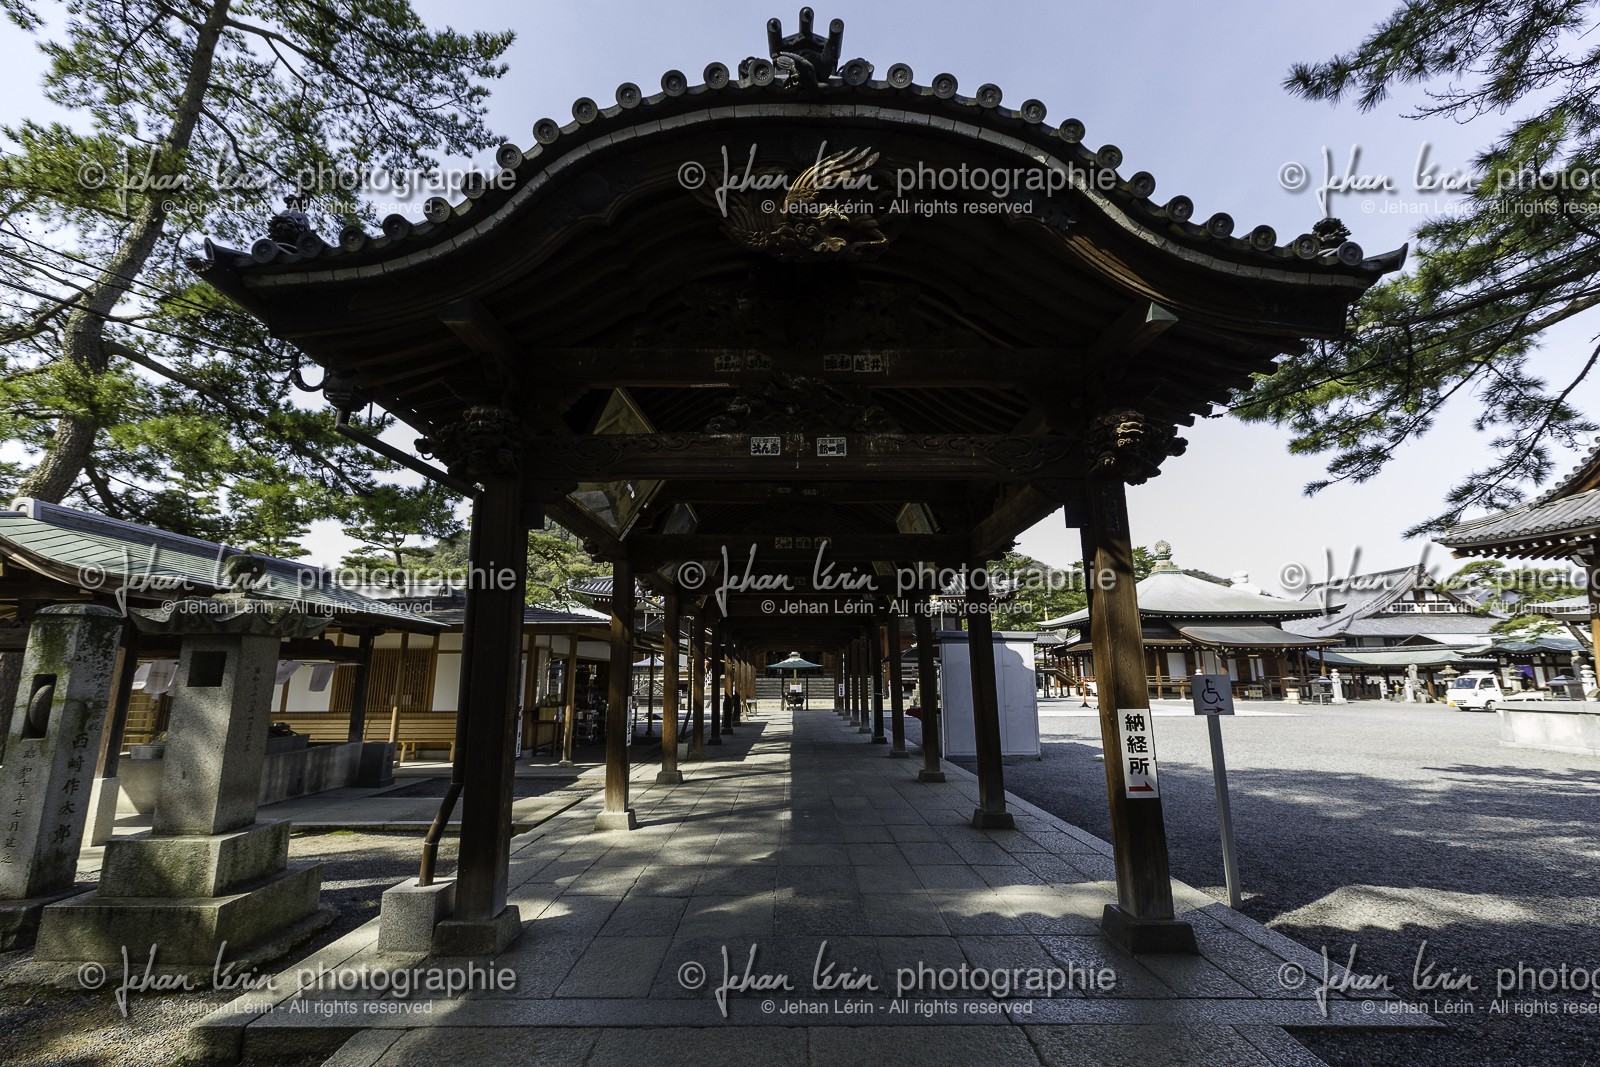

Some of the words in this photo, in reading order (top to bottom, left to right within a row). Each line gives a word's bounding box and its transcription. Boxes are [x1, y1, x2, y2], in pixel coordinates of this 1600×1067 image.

[1124, 713, 1150, 776] 納経所
[1, 748, 36, 864] 昭和十年七月建之
